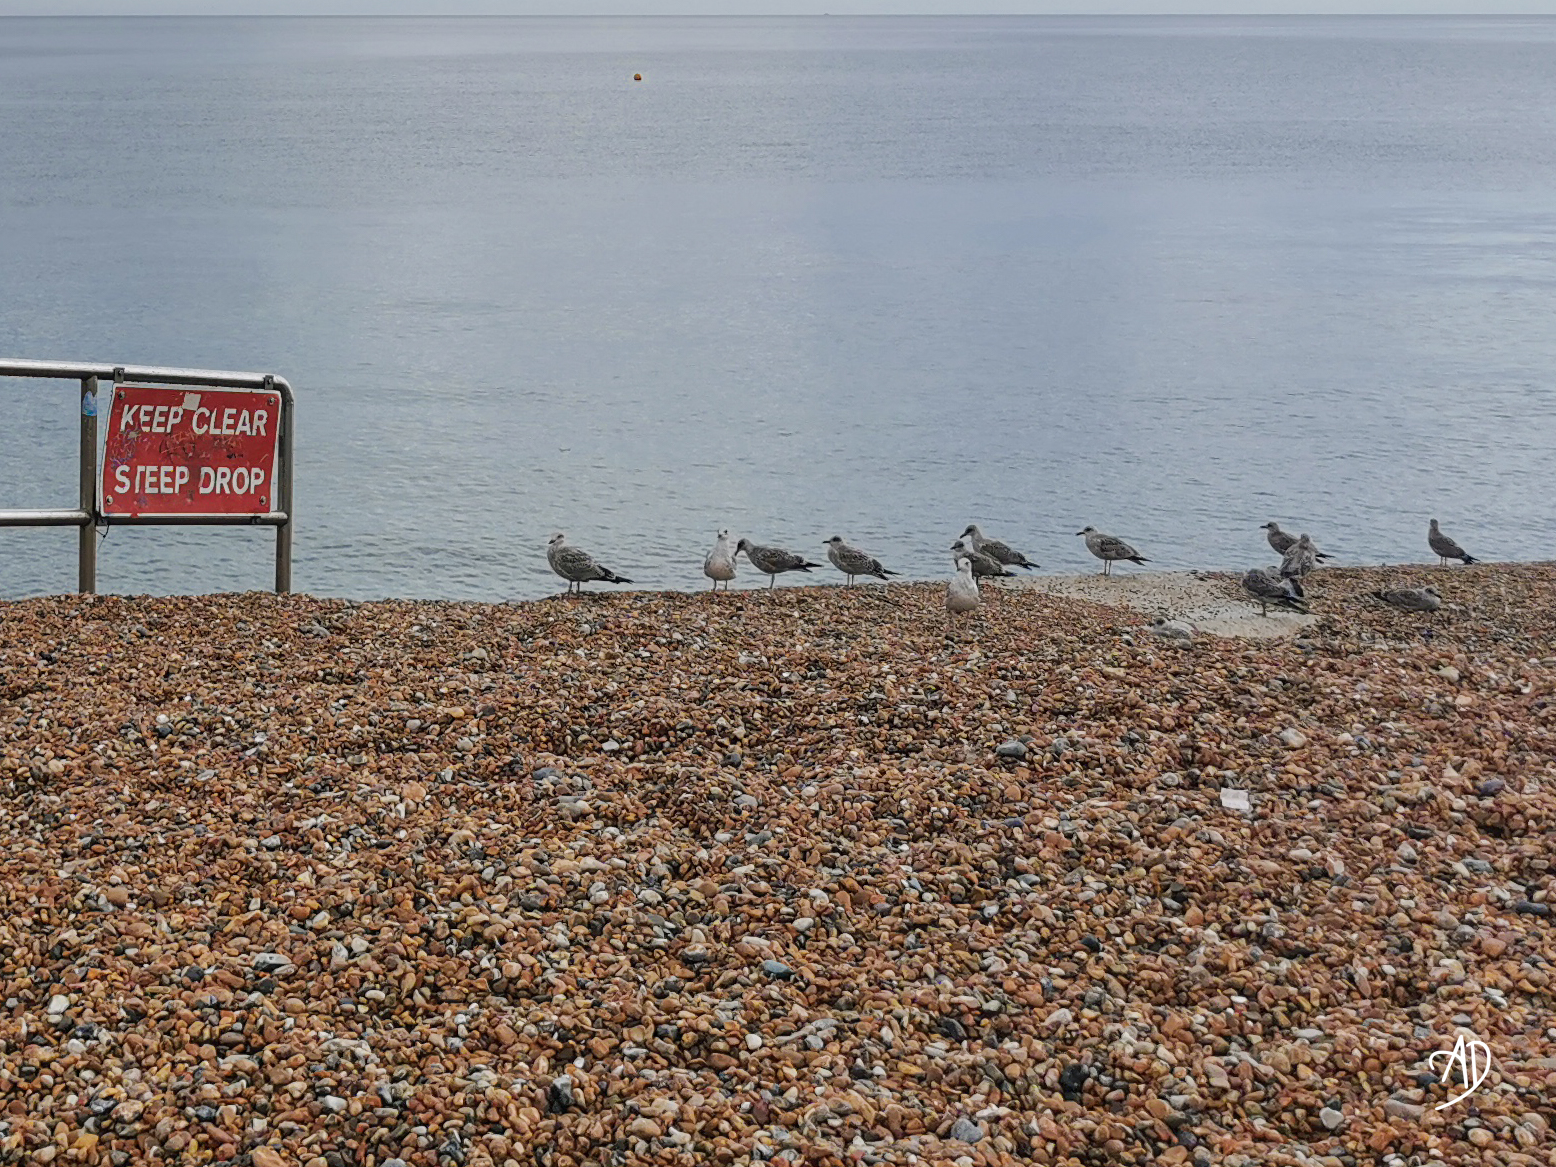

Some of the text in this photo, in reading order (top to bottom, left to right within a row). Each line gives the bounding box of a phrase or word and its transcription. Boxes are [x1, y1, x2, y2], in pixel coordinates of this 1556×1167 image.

[120, 404, 268, 436] KEEP CLEAR
[114, 465, 265, 494] STEEP DROP
